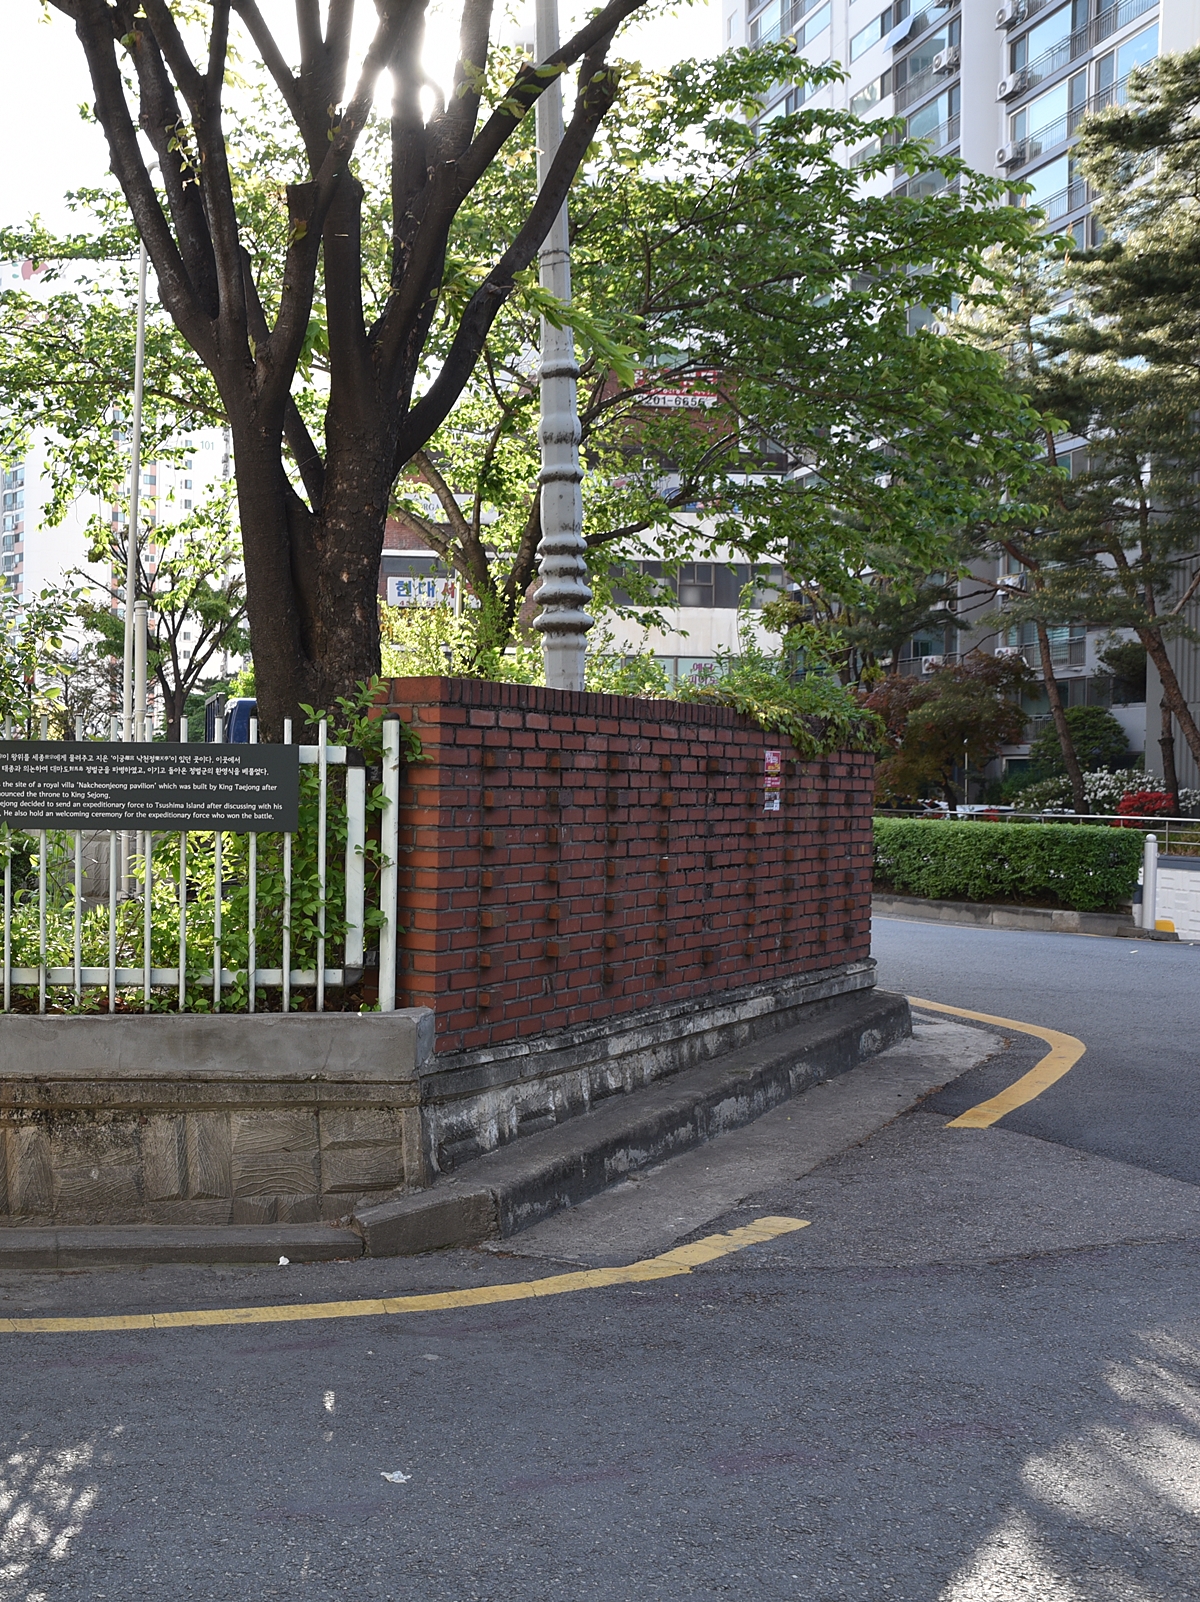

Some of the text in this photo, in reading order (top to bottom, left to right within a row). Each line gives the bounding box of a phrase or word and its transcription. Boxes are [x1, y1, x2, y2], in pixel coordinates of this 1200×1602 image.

[200, 440, 214, 451] 101
[43, 781, 59, 789] royal
[192, 782, 207, 790] built
[209, 783, 217, 791] by
[218, 783, 233, 791] King
[234, 783, 260, 791] Taejong
[70, 791, 85, 799] King
[86, 791, 110, 799] Sejong.
[82, 801, 125, 809] expeditionary
[223, 802, 256, 810] discussing
[29, 809, 43, 817] hold
[55, 810, 89, 818] welcoming
[124, 810, 134, 818] for
[135, 810, 146, 818] the
[148, 811, 191, 819] expeditionary
[211, 811, 225, 819] who
